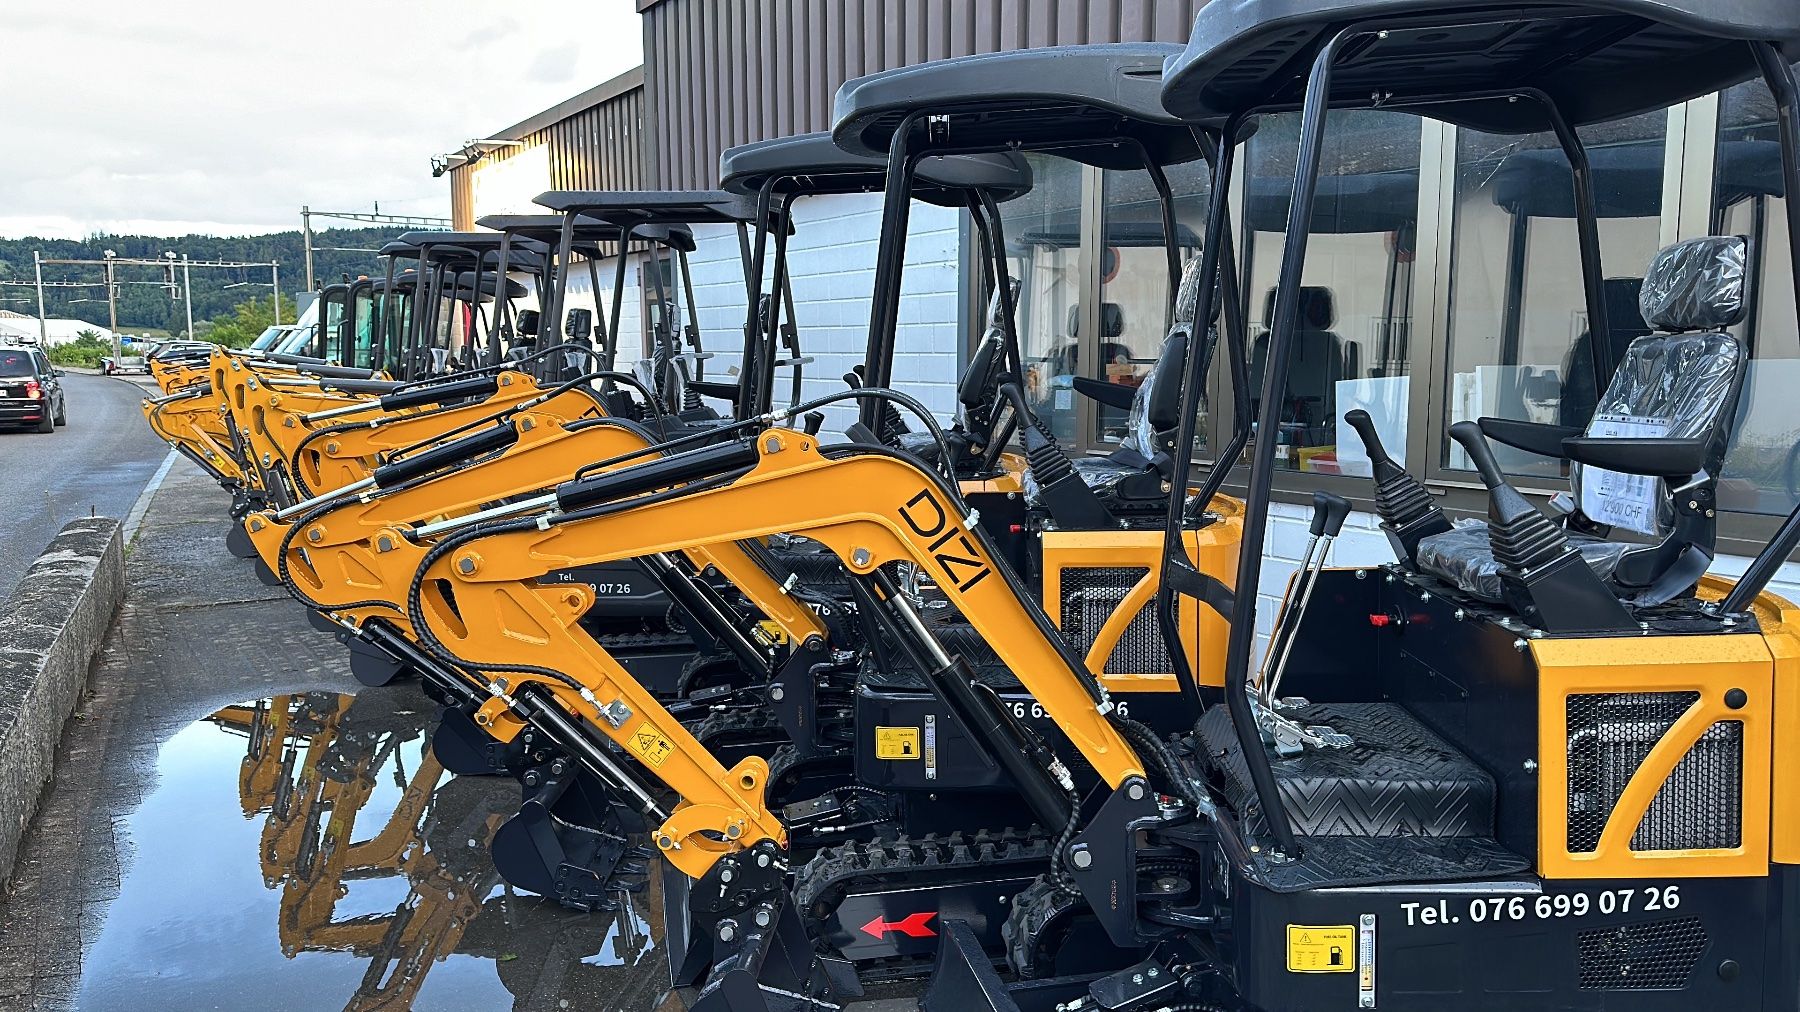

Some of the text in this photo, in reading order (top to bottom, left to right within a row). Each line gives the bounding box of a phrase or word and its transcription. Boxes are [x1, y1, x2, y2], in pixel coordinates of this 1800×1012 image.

[1624, 504, 1642, 519] CHF
[898, 488, 991, 593] DIZI
[558, 573, 575, 581] Tel.
[599, 583, 614, 594] 07
[616, 583, 631, 594] 26
[1400, 885, 1680, 926] Tel. 076 699 07 26
